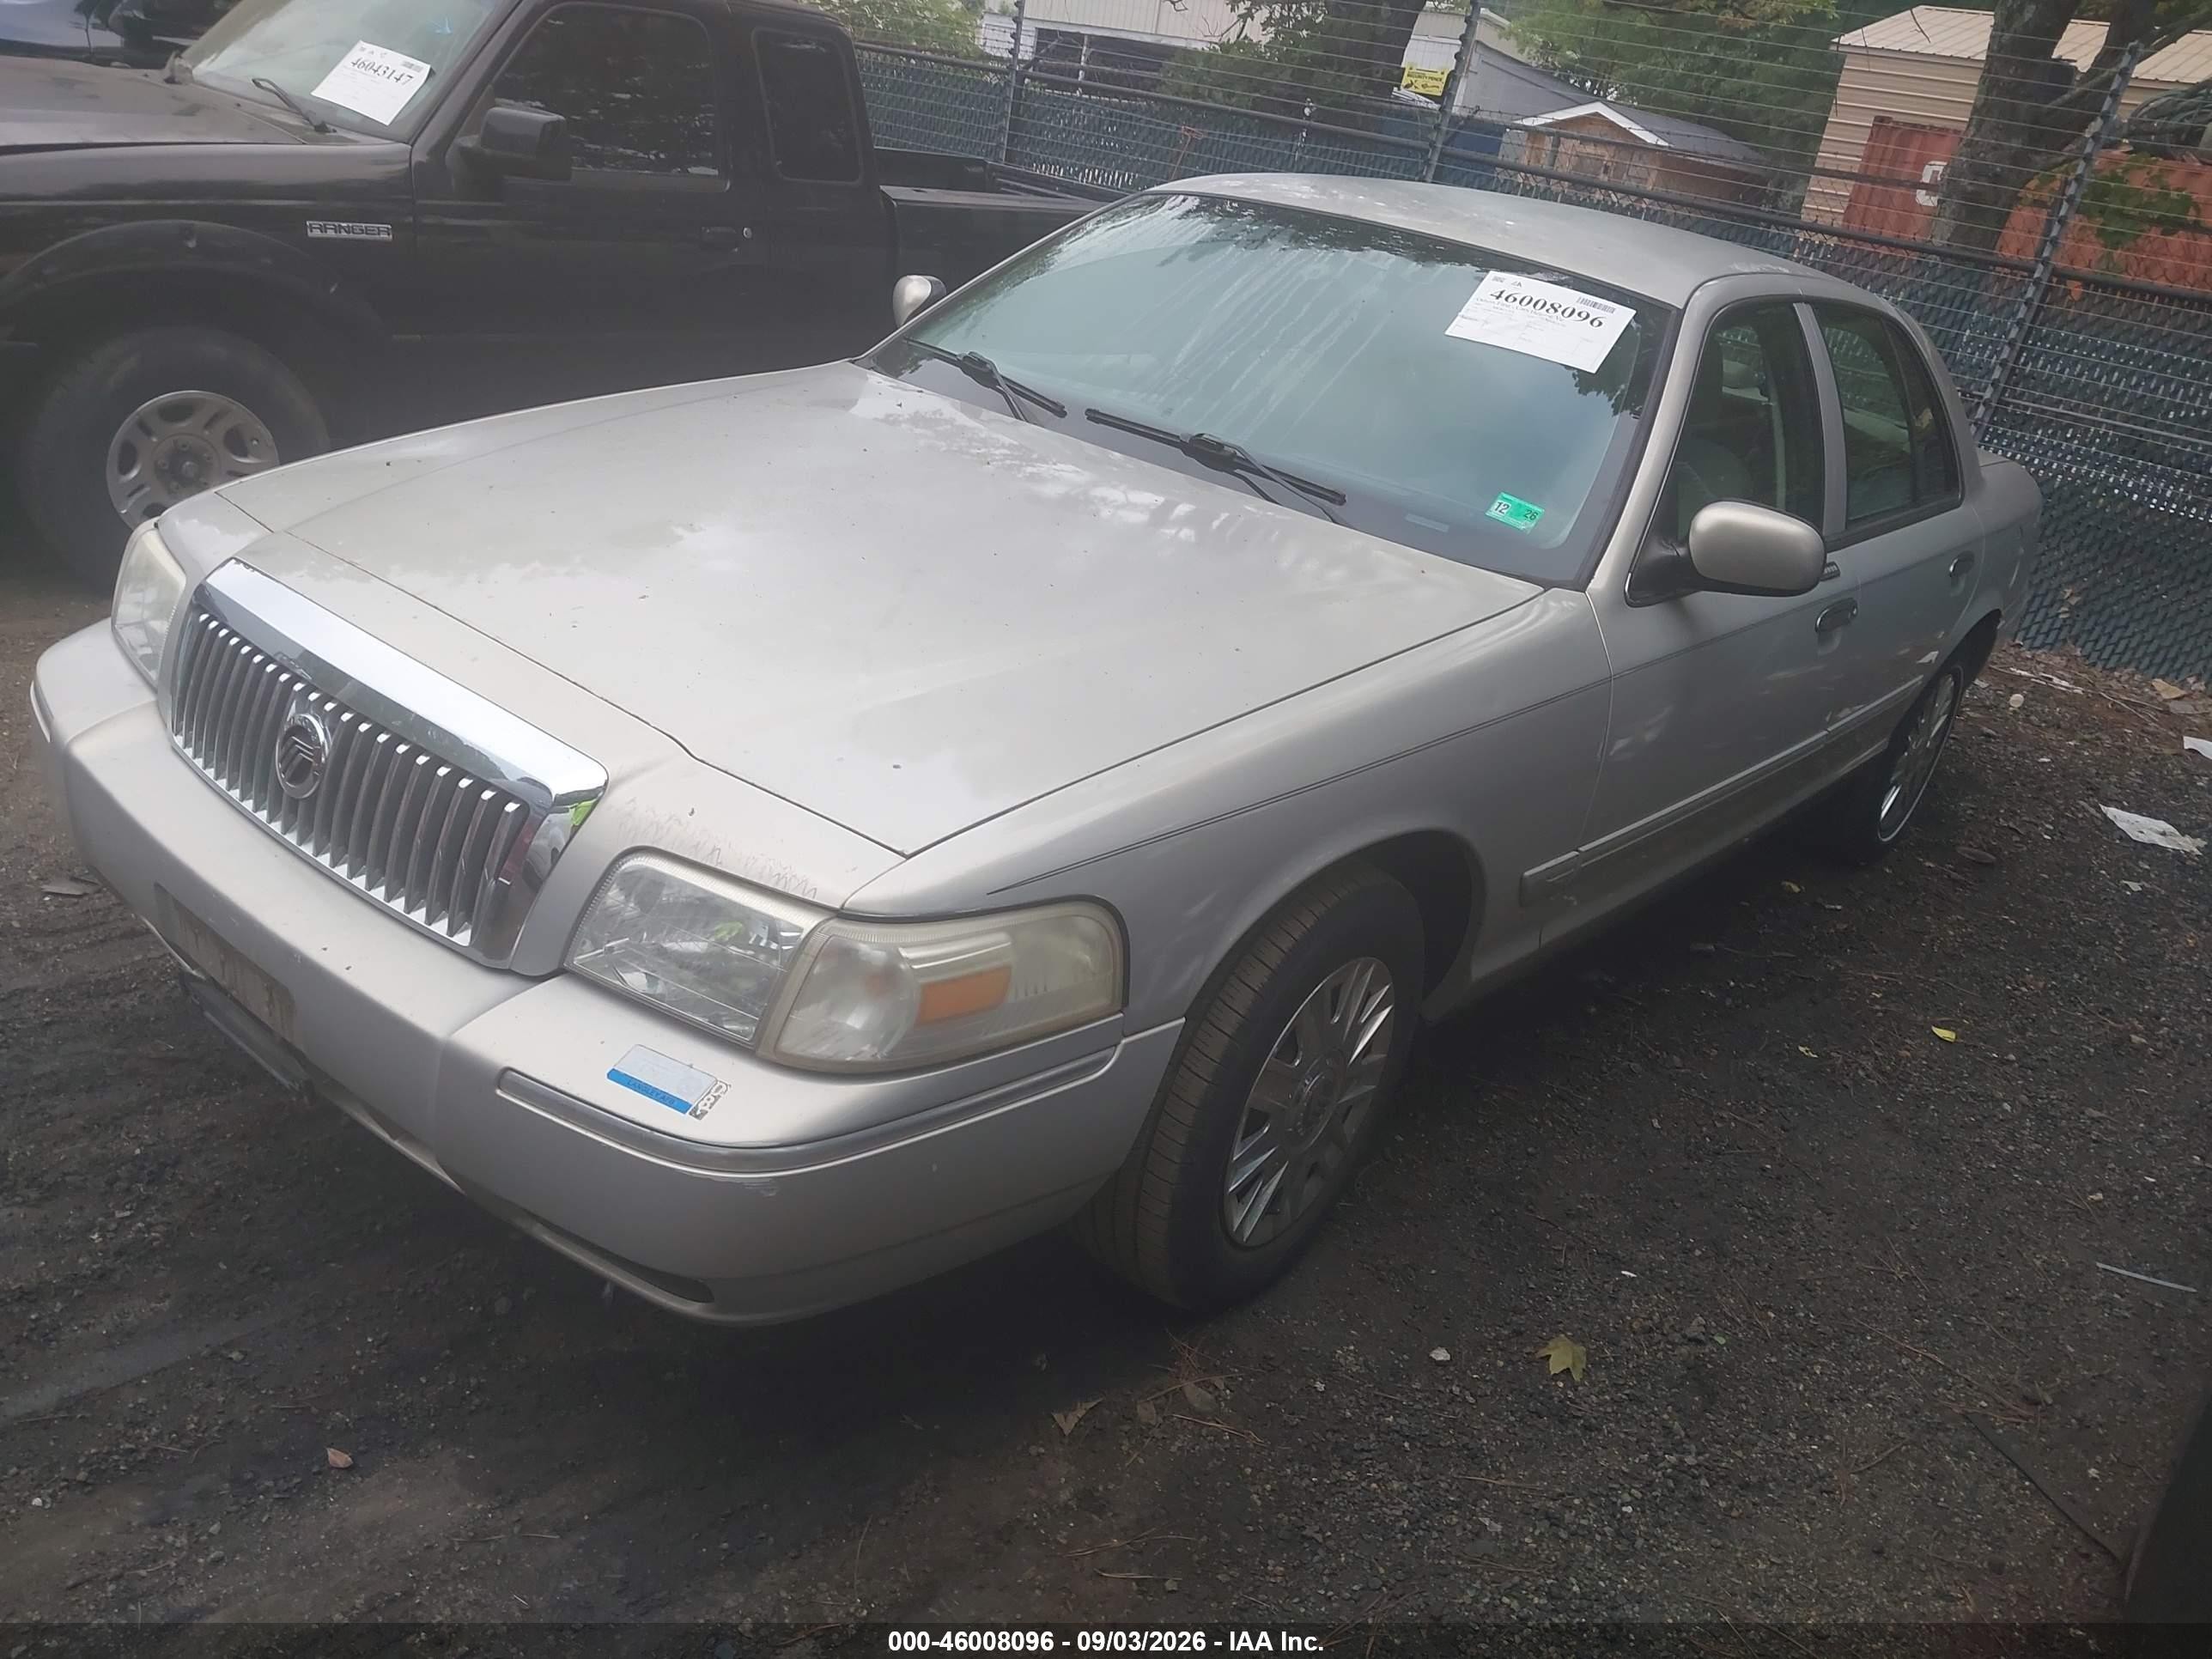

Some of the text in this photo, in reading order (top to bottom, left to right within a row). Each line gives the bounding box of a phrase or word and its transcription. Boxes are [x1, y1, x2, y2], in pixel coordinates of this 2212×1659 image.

[350, 57, 414, 85] 46043147
[307, 222, 392, 236] RANGER
[1490, 289, 1608, 329] 46008096
[1494, 501, 1510, 514] 12
[1523, 509, 1538, 520] 26
